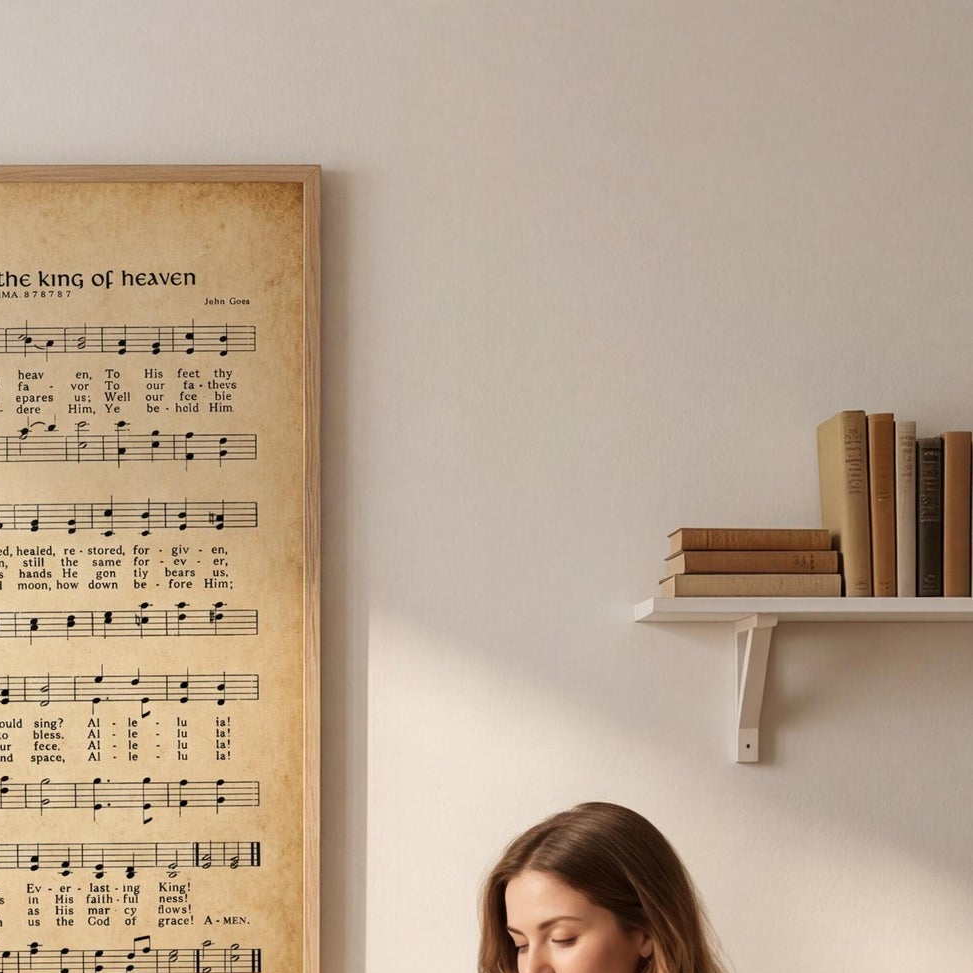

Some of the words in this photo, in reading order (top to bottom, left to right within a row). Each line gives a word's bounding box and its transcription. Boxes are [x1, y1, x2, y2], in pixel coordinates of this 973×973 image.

[38, 271, 83, 289] king
[92, 270, 113, 289] of
[122, 270, 195, 286] heaven
[18, 370, 44, 380] heav
[105, 369, 120, 378] To
[145, 369, 163, 378] His
[178, 368, 200, 378] feet
[214, 368, 232, 380] thy
[18, 382, 29, 391] fa
[104, 381, 120, 390] To
[104, 392, 130, 402] Well
[16, 405, 41, 414] dere
[105, 403, 120, 413] Ye
[147, 403, 159, 413] be
[209, 403, 232, 412] Him
[88, 545, 125, 556] stored,
[133, 545, 150, 555] for
[172, 544, 189, 557] giv
[211, 547, 227, 555] en,
[23, 557, 44, 567] still
[61, 557, 78, 567] the
[92, 559, 121, 567] same
[134, 557, 150, 566] for
[19, 569, 52, 578] hands
[62, 568, 78, 578] He
[96, 571, 116, 580] gon
[18, 583, 51, 591] moon,
[57, 580, 79, 589] how
[88, 580, 118, 589] down
[134, 579, 147, 589] be
[169, 579, 192, 588] fore
[34, 718, 63, 730] sing?
[27, 883, 41, 893] Ev
[90, 883, 110, 892] last
[123, 885, 140, 895] ing
[159, 882, 190, 894] King!
[159, 894, 187, 903] ness!
[56, 916, 74, 926] the
[125, 916, 136, 925] of
[158, 915, 193, 928] grace!
